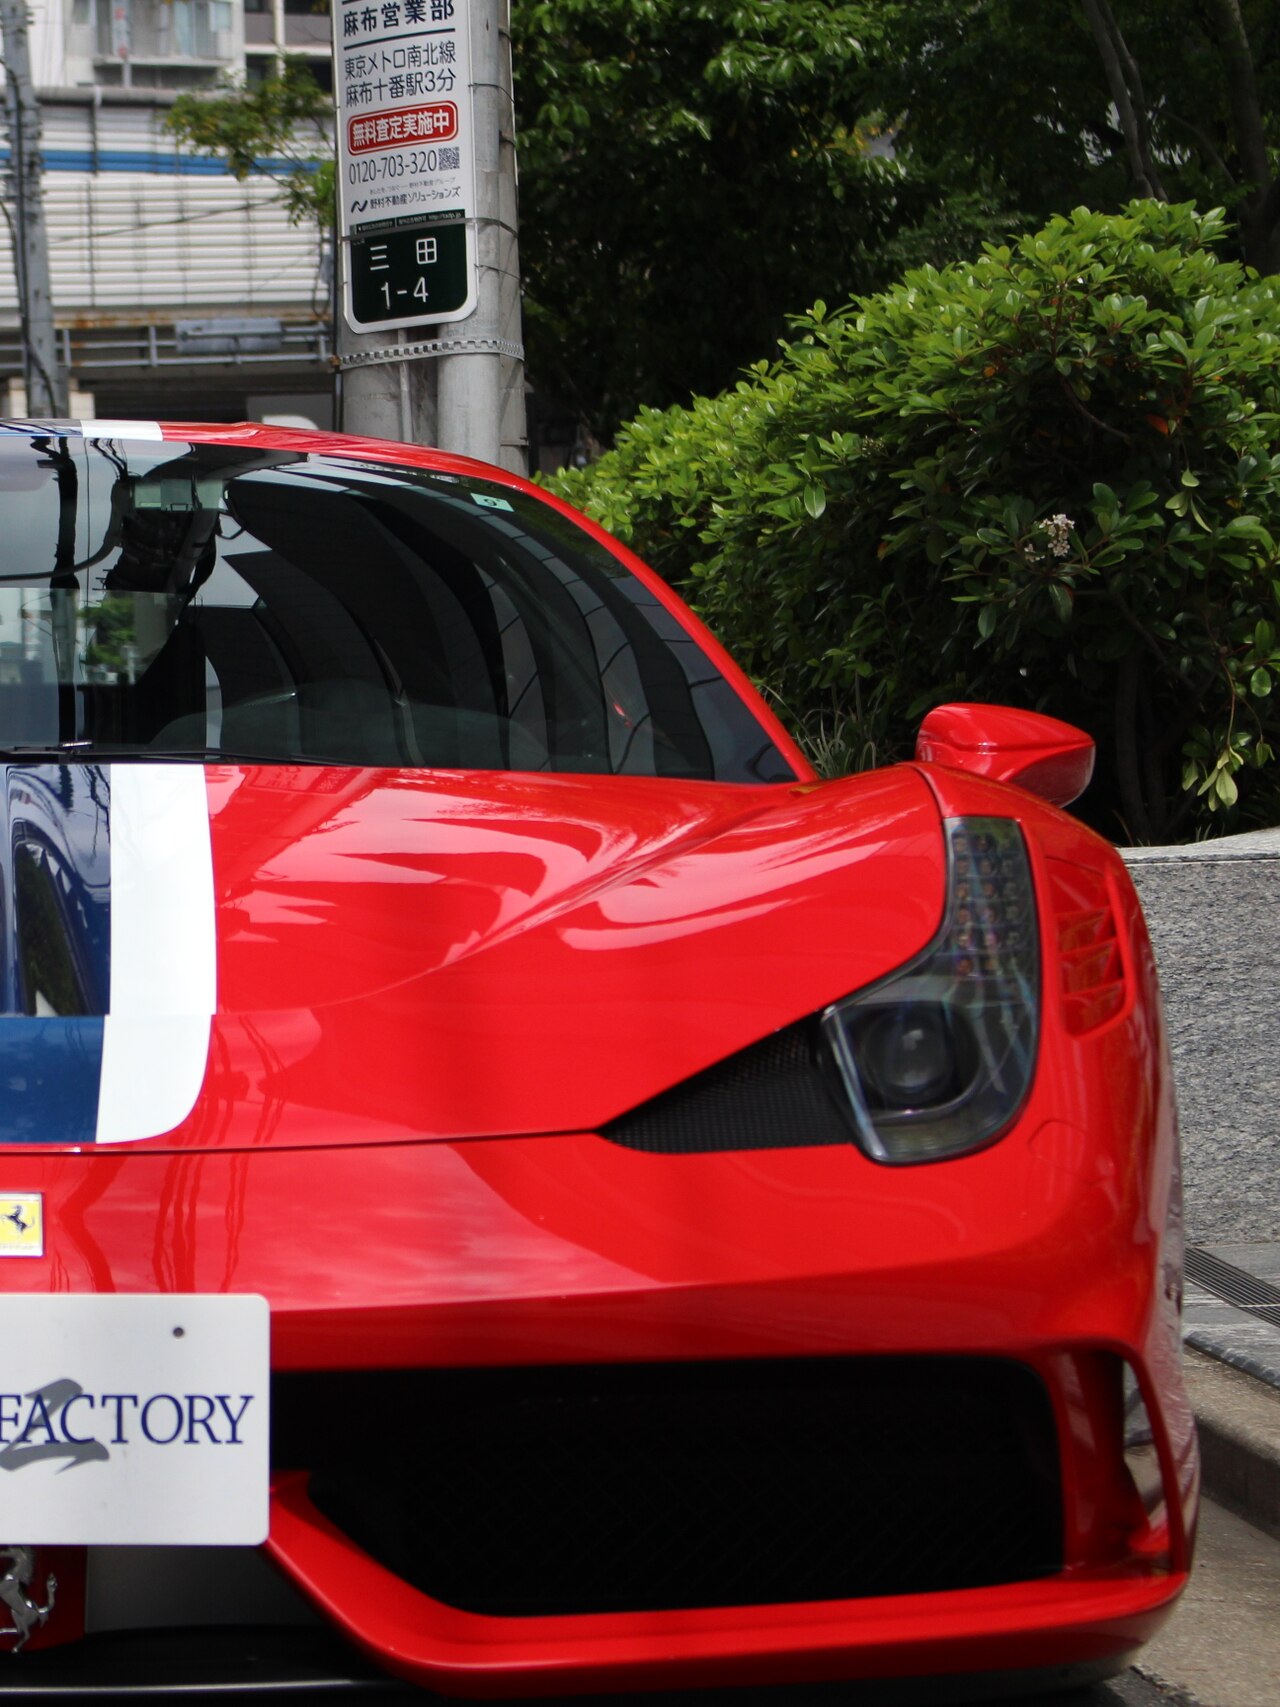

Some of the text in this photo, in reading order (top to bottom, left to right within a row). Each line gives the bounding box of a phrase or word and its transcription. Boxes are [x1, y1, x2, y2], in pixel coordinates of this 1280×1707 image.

[343, 0, 455, 37] 麻布営業部
[344, 40, 456, 81] 東京メトロ南北線
[345, 68, 457, 108] 麻布十番駅3分
[352, 109, 450, 147] 無料査定実施中
[349, 150, 438, 184] 0120-703-320
[380, 276, 429, 310] 1-4
